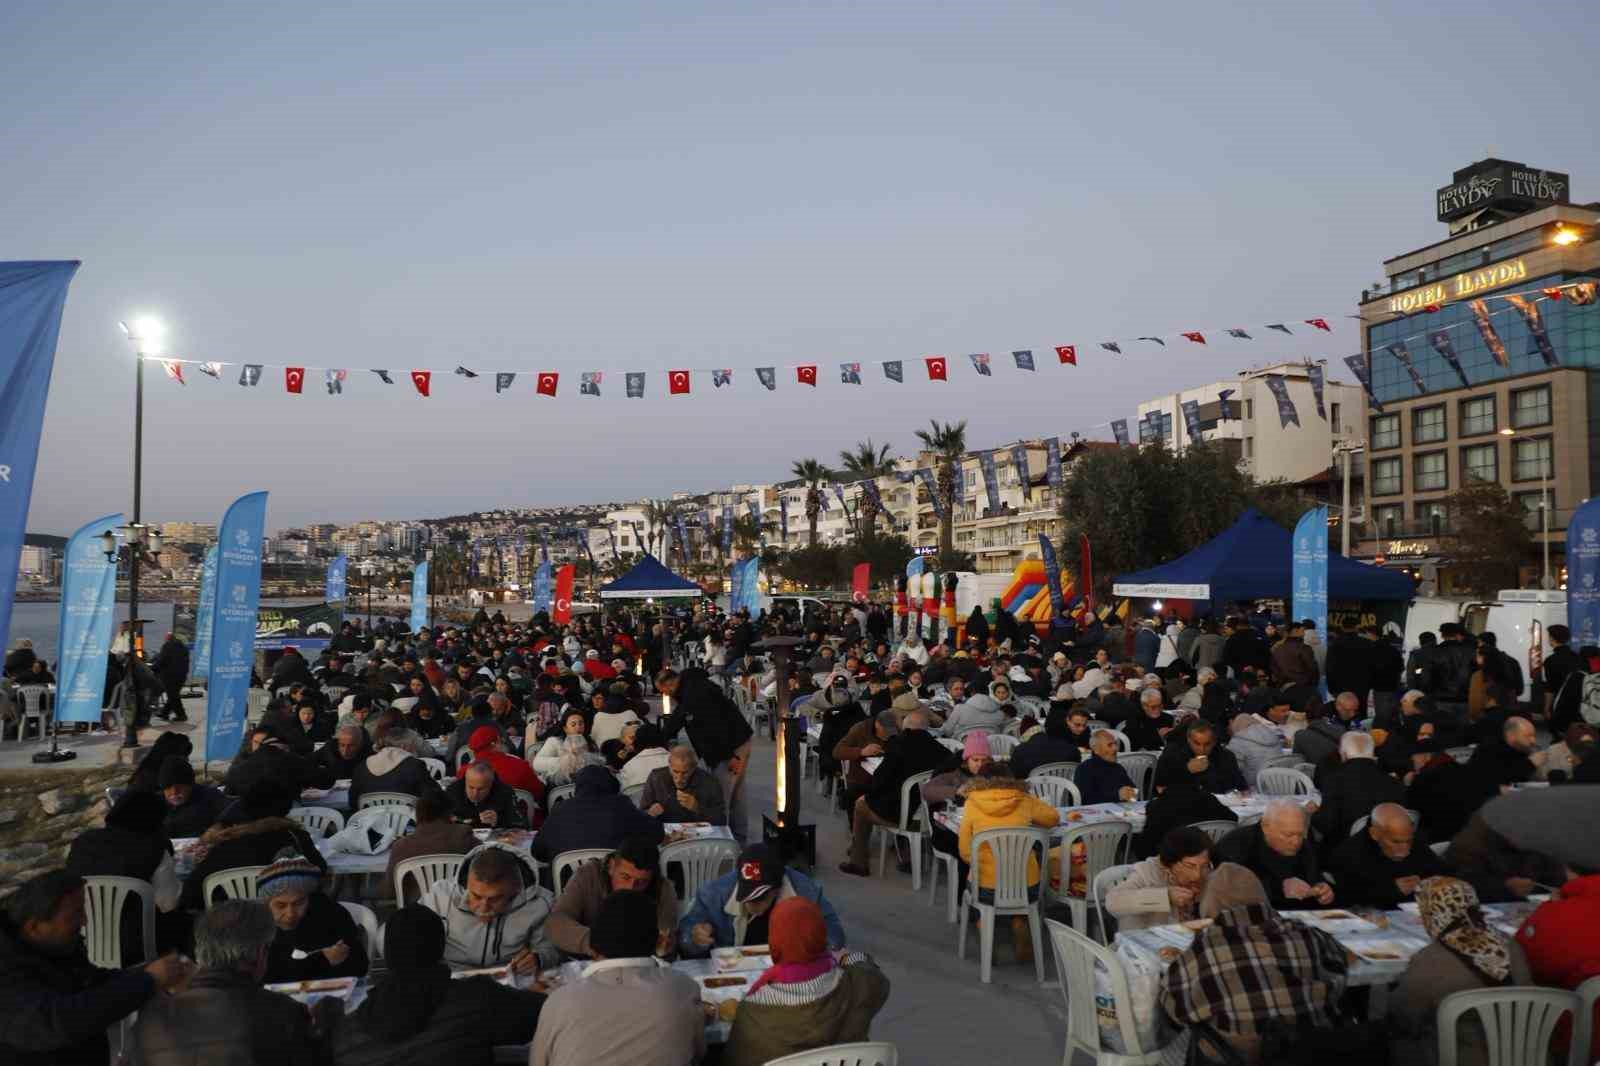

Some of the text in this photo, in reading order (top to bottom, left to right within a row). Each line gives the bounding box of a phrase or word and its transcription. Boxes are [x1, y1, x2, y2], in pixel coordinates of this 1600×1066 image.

[1512, 168, 1537, 182] HOTEL
[1440, 184, 1473, 201] HOTEL
[1391, 284, 1446, 312] HOTEL
